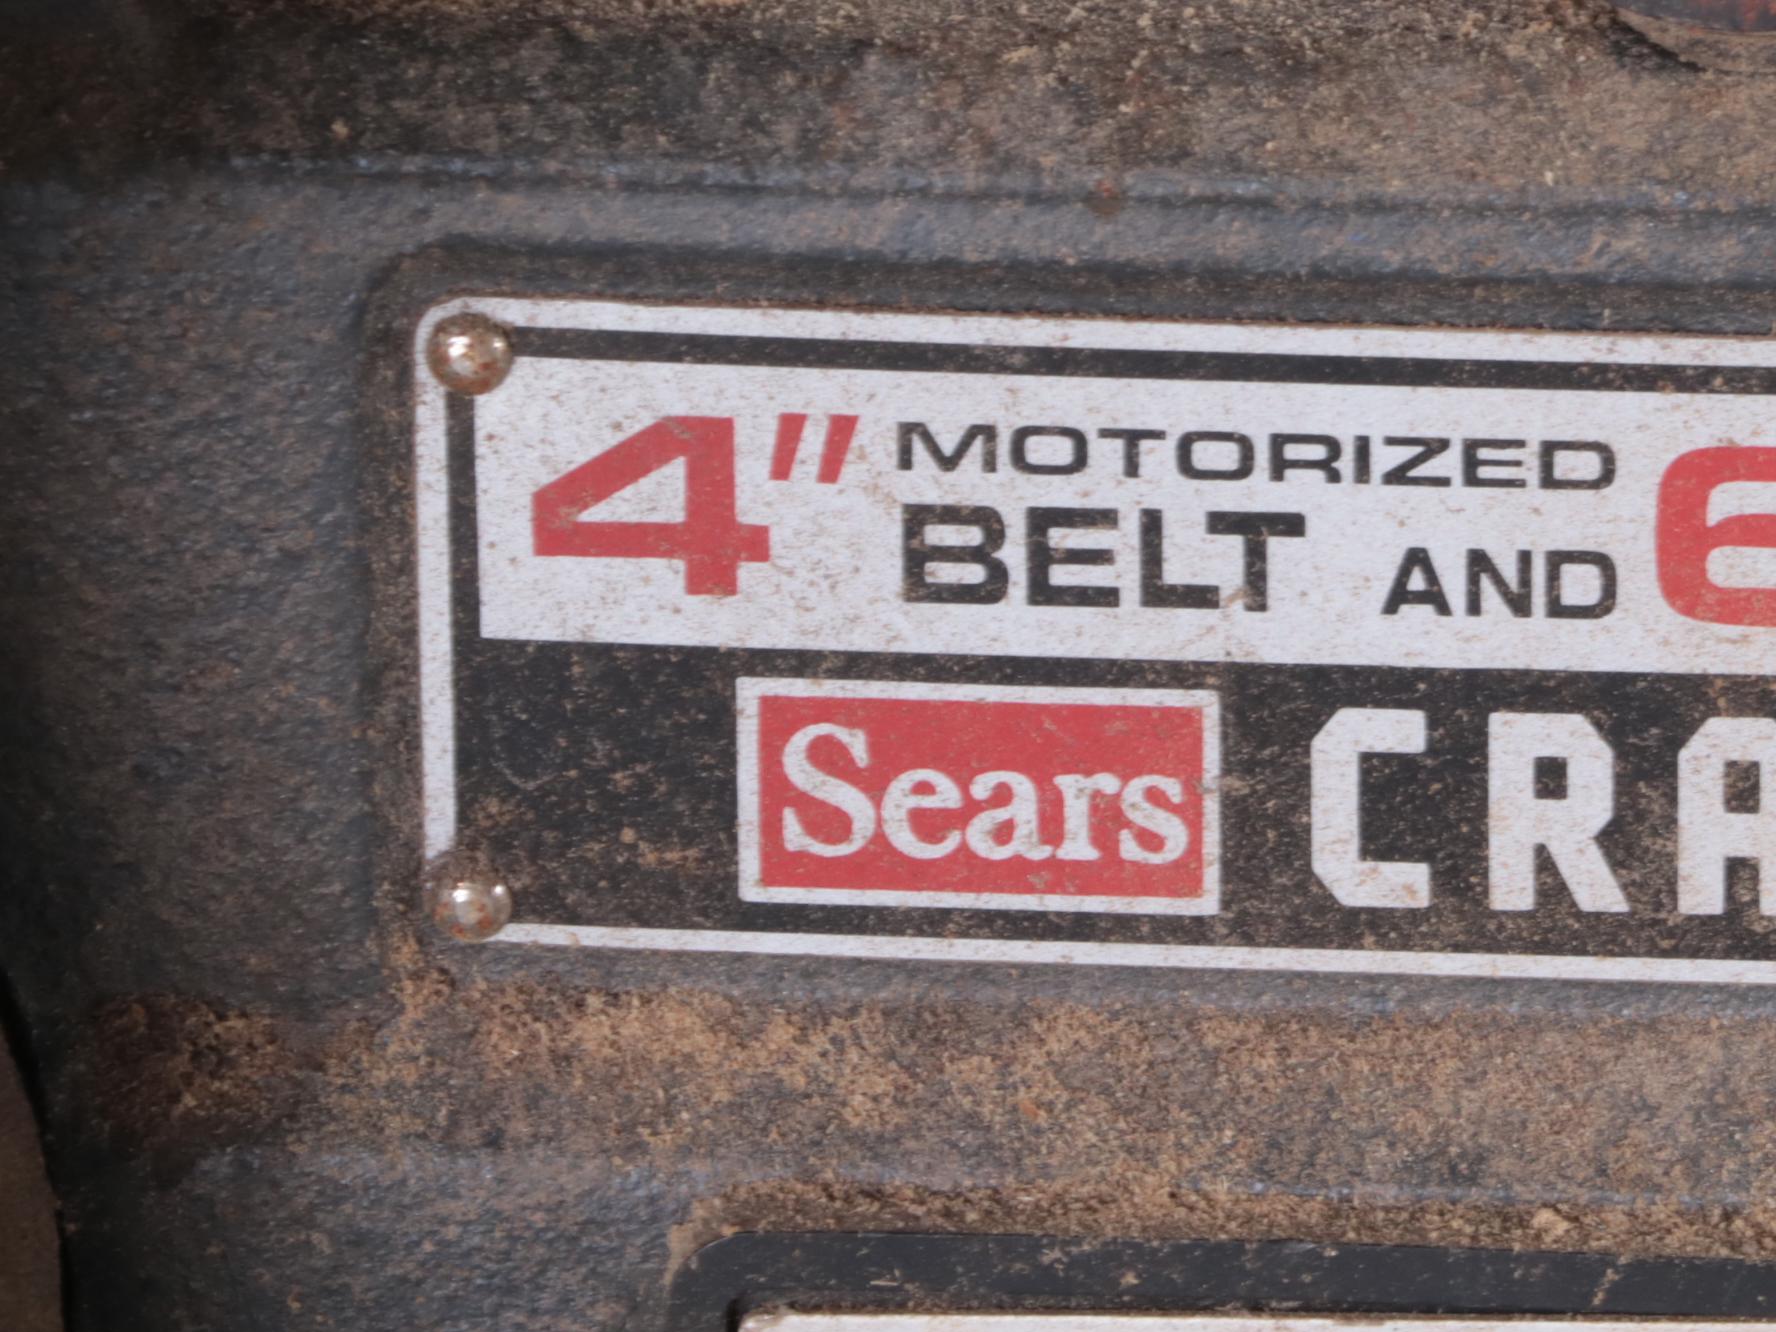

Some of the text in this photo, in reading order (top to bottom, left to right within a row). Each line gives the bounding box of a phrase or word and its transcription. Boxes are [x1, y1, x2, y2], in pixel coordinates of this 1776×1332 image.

[533, 412, 860, 596] 4"
[896, 421, 1617, 489] MOTORIZED
[902, 504, 1307, 612] BELT
[1382, 548, 1618, 619] AND
[780, 722, 1190, 865] Sears
